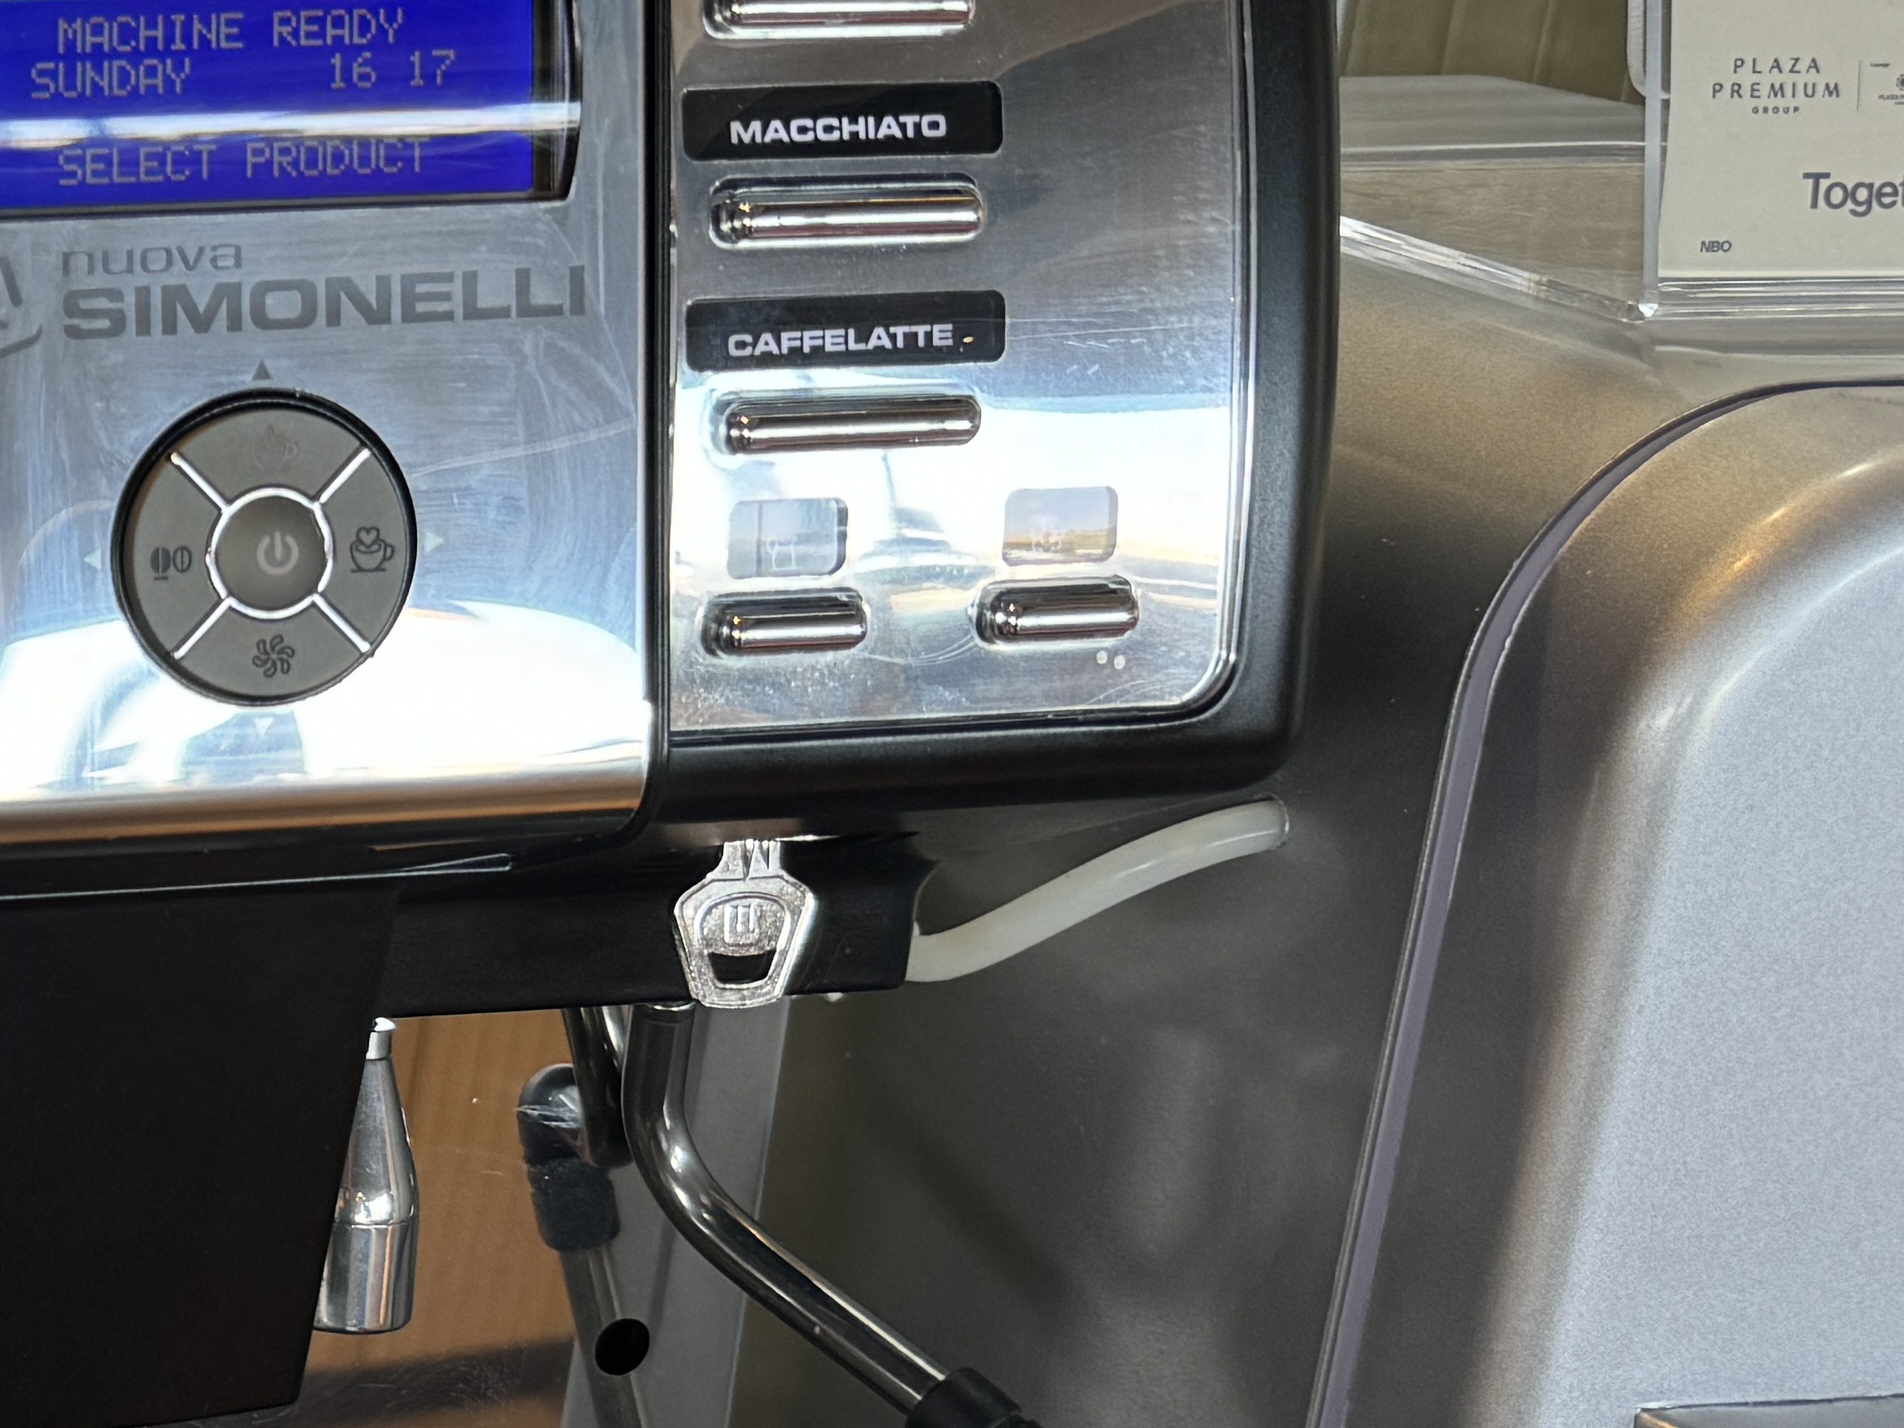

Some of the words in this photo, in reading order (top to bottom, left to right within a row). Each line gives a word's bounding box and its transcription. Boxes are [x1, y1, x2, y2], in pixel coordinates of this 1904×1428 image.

[57, 12, 245, 55] MACHINE
[272, 6, 405, 48] READY
[30, 57, 192, 101] SUNDAY
[330, 51, 378, 91] 16
[409, 48, 457, 89] 17
[1733, 57, 1820, 74] PLAZA
[1712, 82, 1840, 99] PREMIUM
[1752, 106, 1800, 114] GROUP
[729, 113, 947, 145] MACCHIATO
[57, 143, 217, 187] SELECT
[246, 138, 429, 179] PRODUCT
[62, 242, 243, 277] nuova
[1700, 240, 1732, 253] NBO
[62, 265, 586, 341] SIMONELLI
[727, 323, 954, 358] CAFFELATTE
